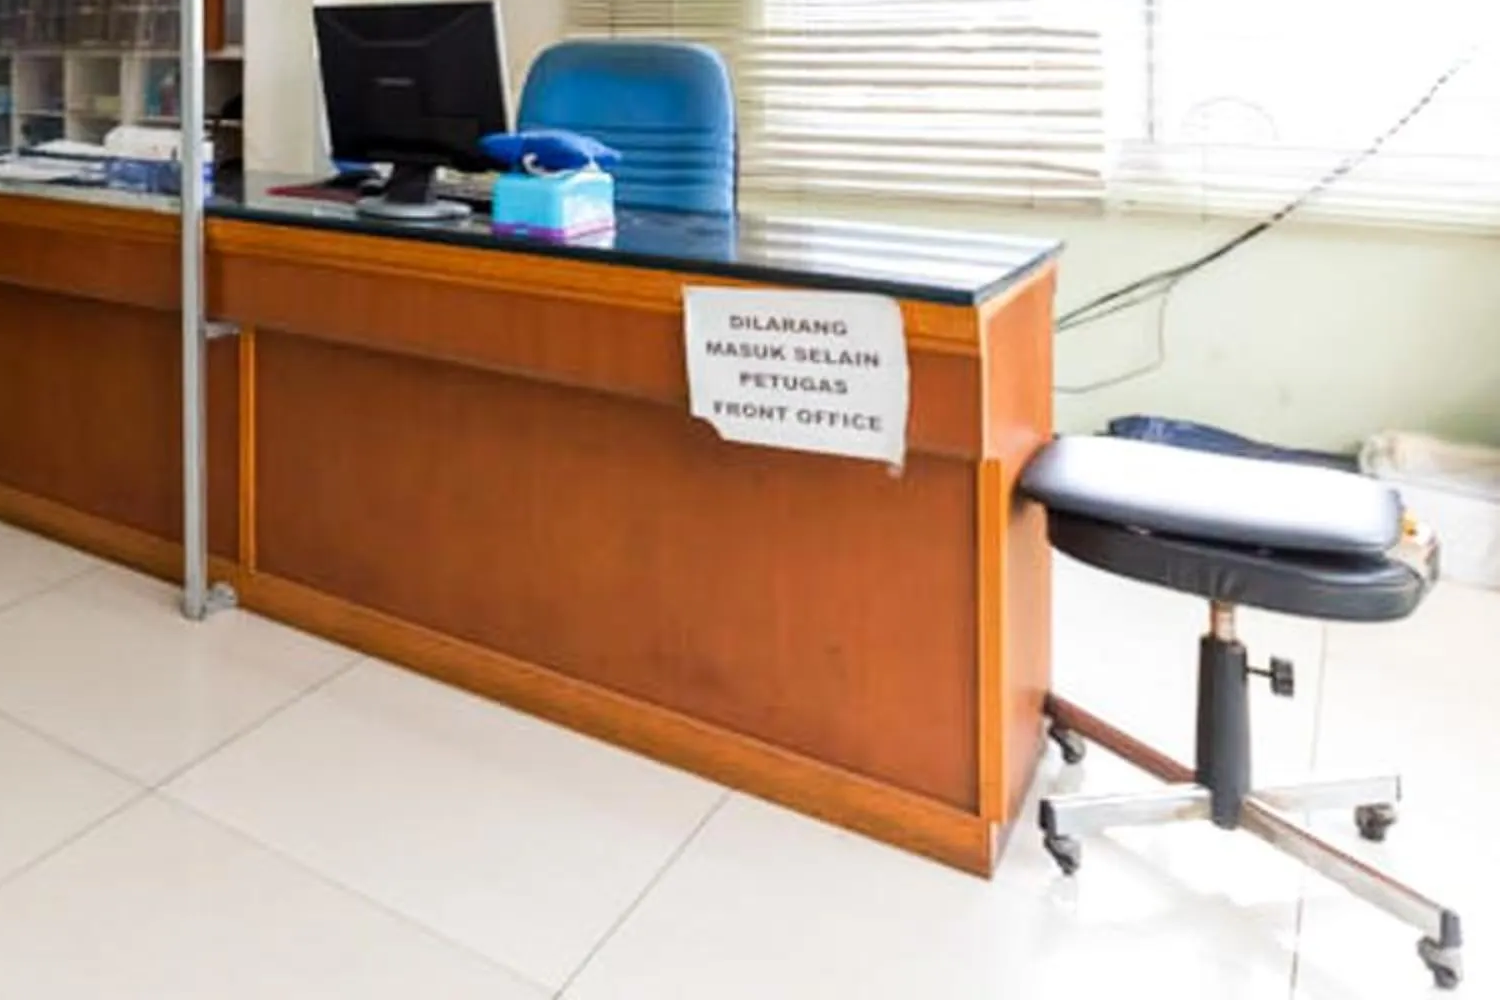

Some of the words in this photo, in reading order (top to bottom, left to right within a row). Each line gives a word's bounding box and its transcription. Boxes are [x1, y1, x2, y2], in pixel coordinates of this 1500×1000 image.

[728, 314, 849, 337] DILARANG
[705, 339, 787, 362] MASUK
[793, 345, 880, 369] SELAIN
[739, 371, 849, 395] PETUGAS
[712, 399, 788, 422] FRONT
[796, 408, 884, 432] OFFICE
